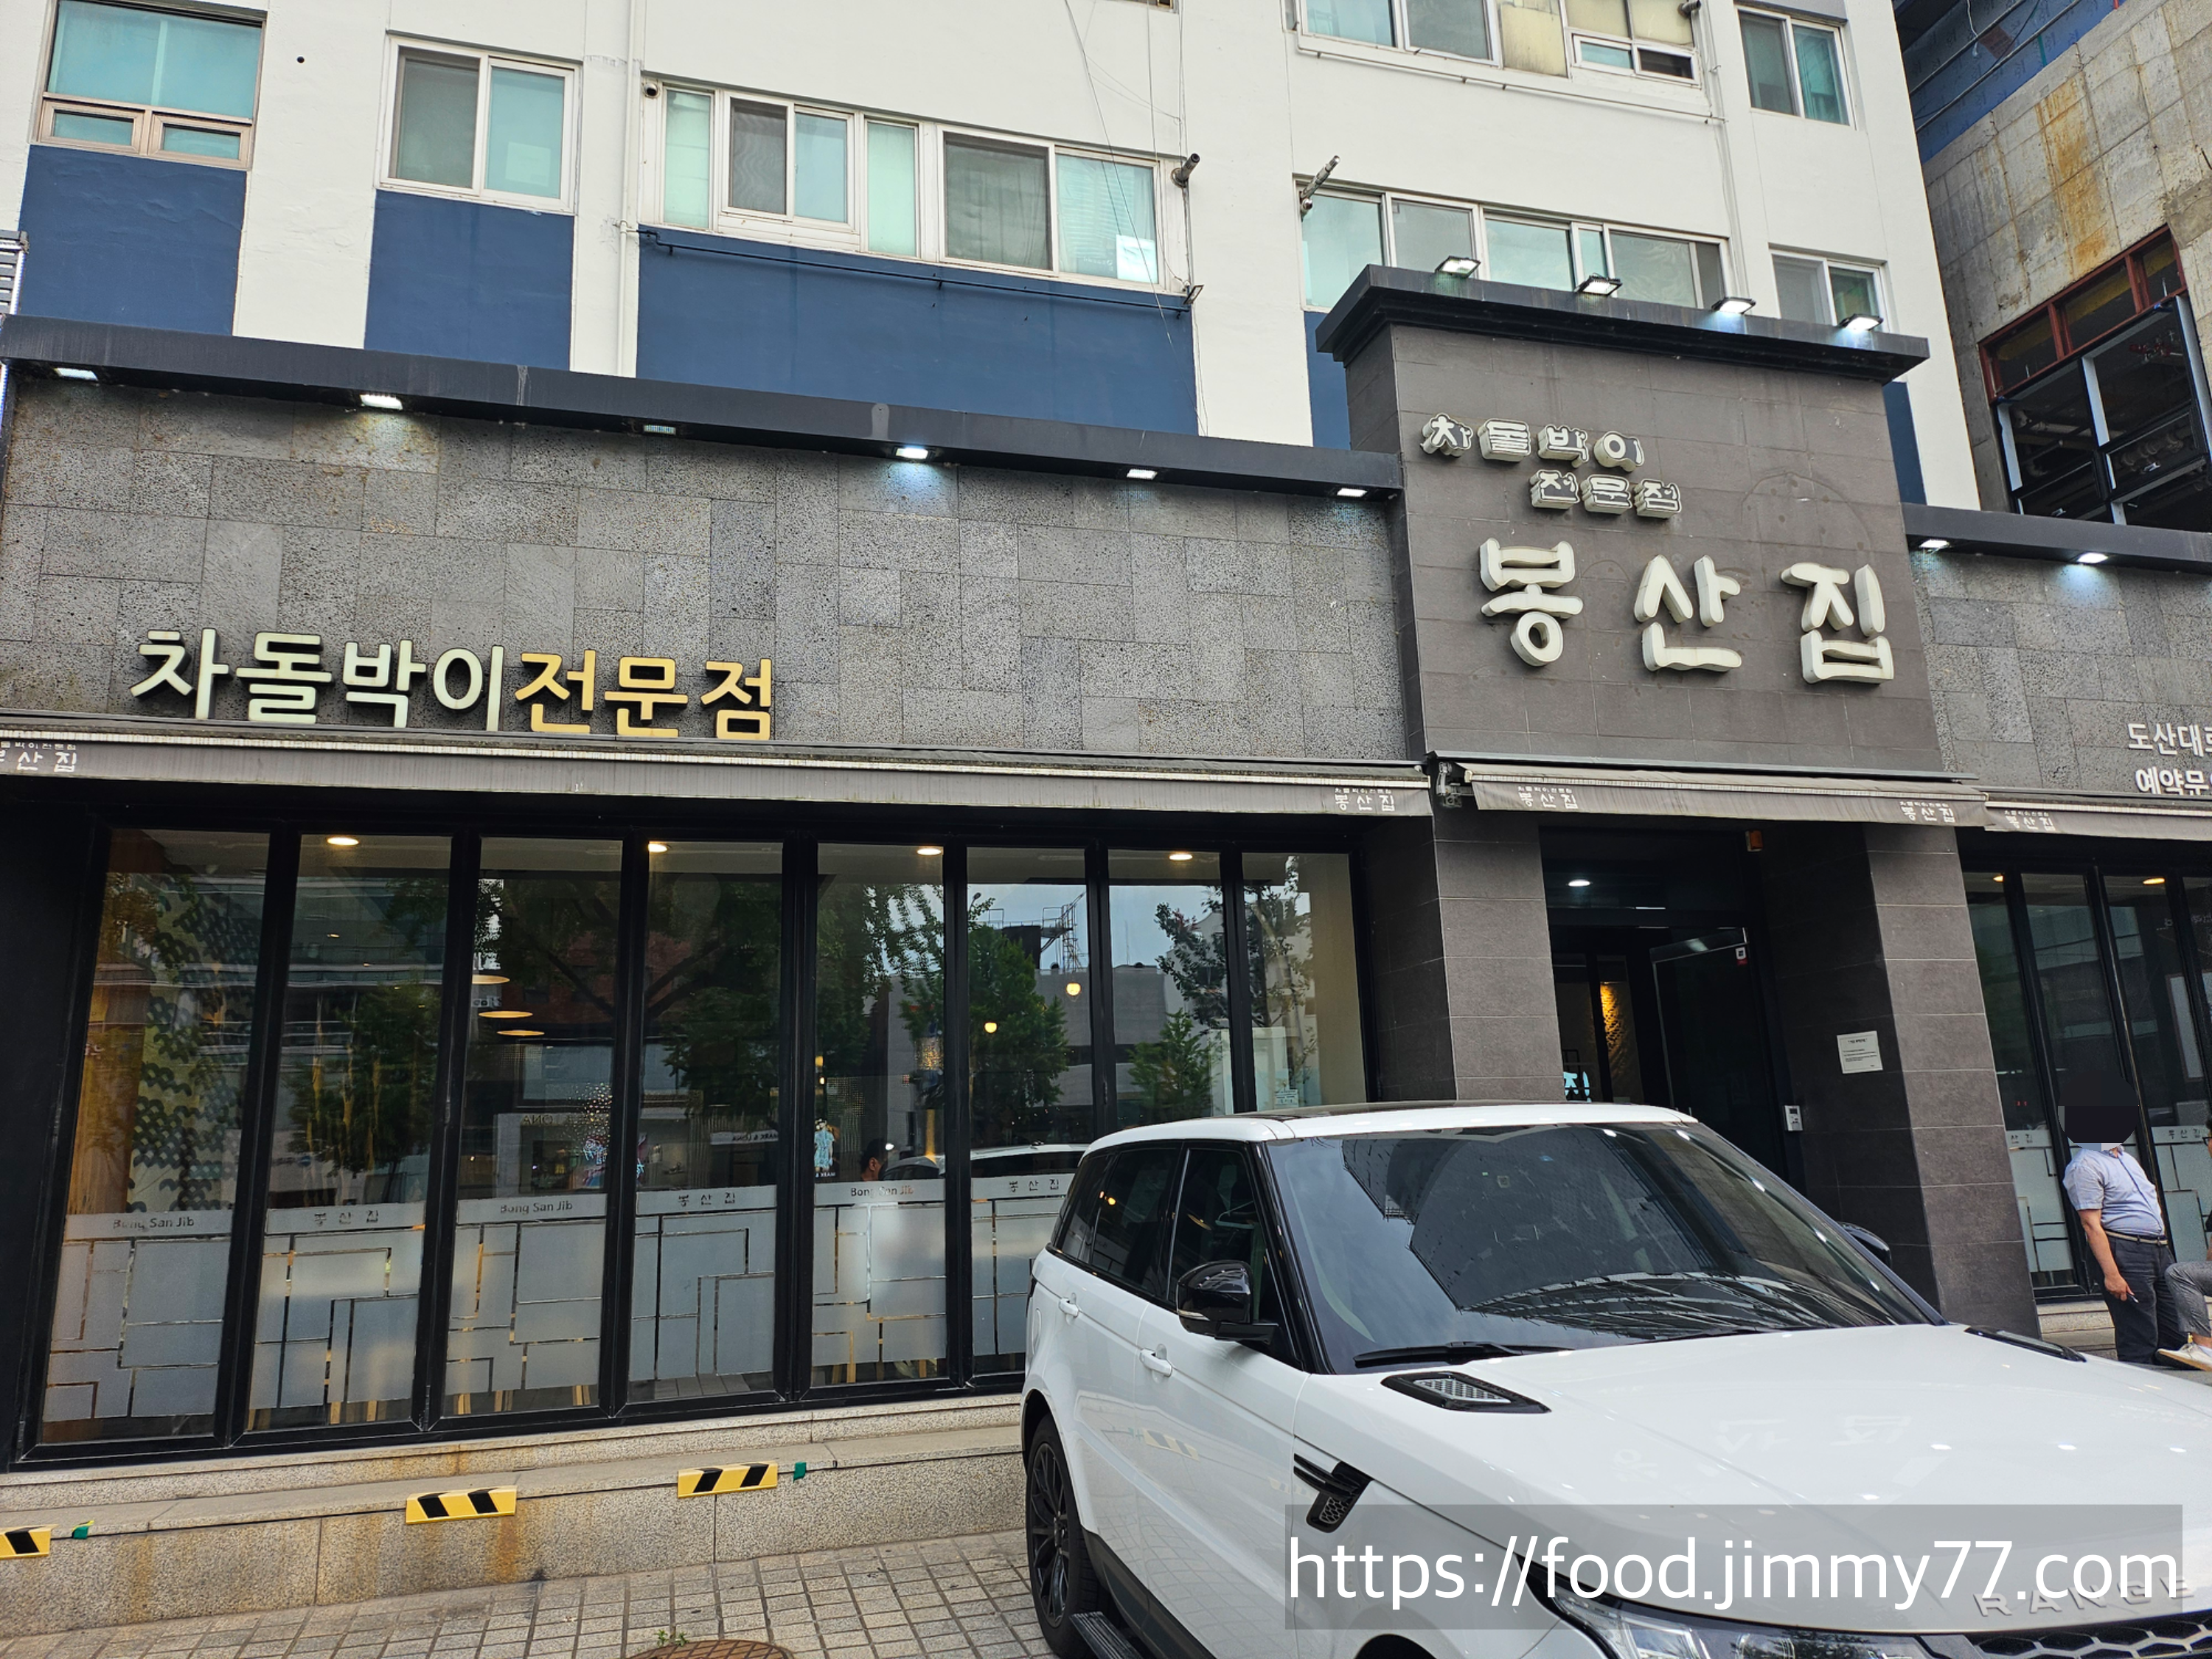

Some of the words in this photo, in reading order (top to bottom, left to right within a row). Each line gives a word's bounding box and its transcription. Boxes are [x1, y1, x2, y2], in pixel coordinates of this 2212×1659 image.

[1422, 412, 1645, 472] 차돌박이
[1530, 469, 1683, 518] 전문점
[1480, 538, 1894, 684] 봉산집
[0, 749, 77, 773] 산집
[2135, 766, 2212, 796] 예약문
[1335, 794, 1395, 811] 봉산집
[1518, 792, 1579, 809] 봉산집
[532, 1202, 554, 1213] San
[557, 1200, 573, 1211] Jib
[149, 1217, 173, 1228] San
[175, 1216, 195, 1228] Jib
